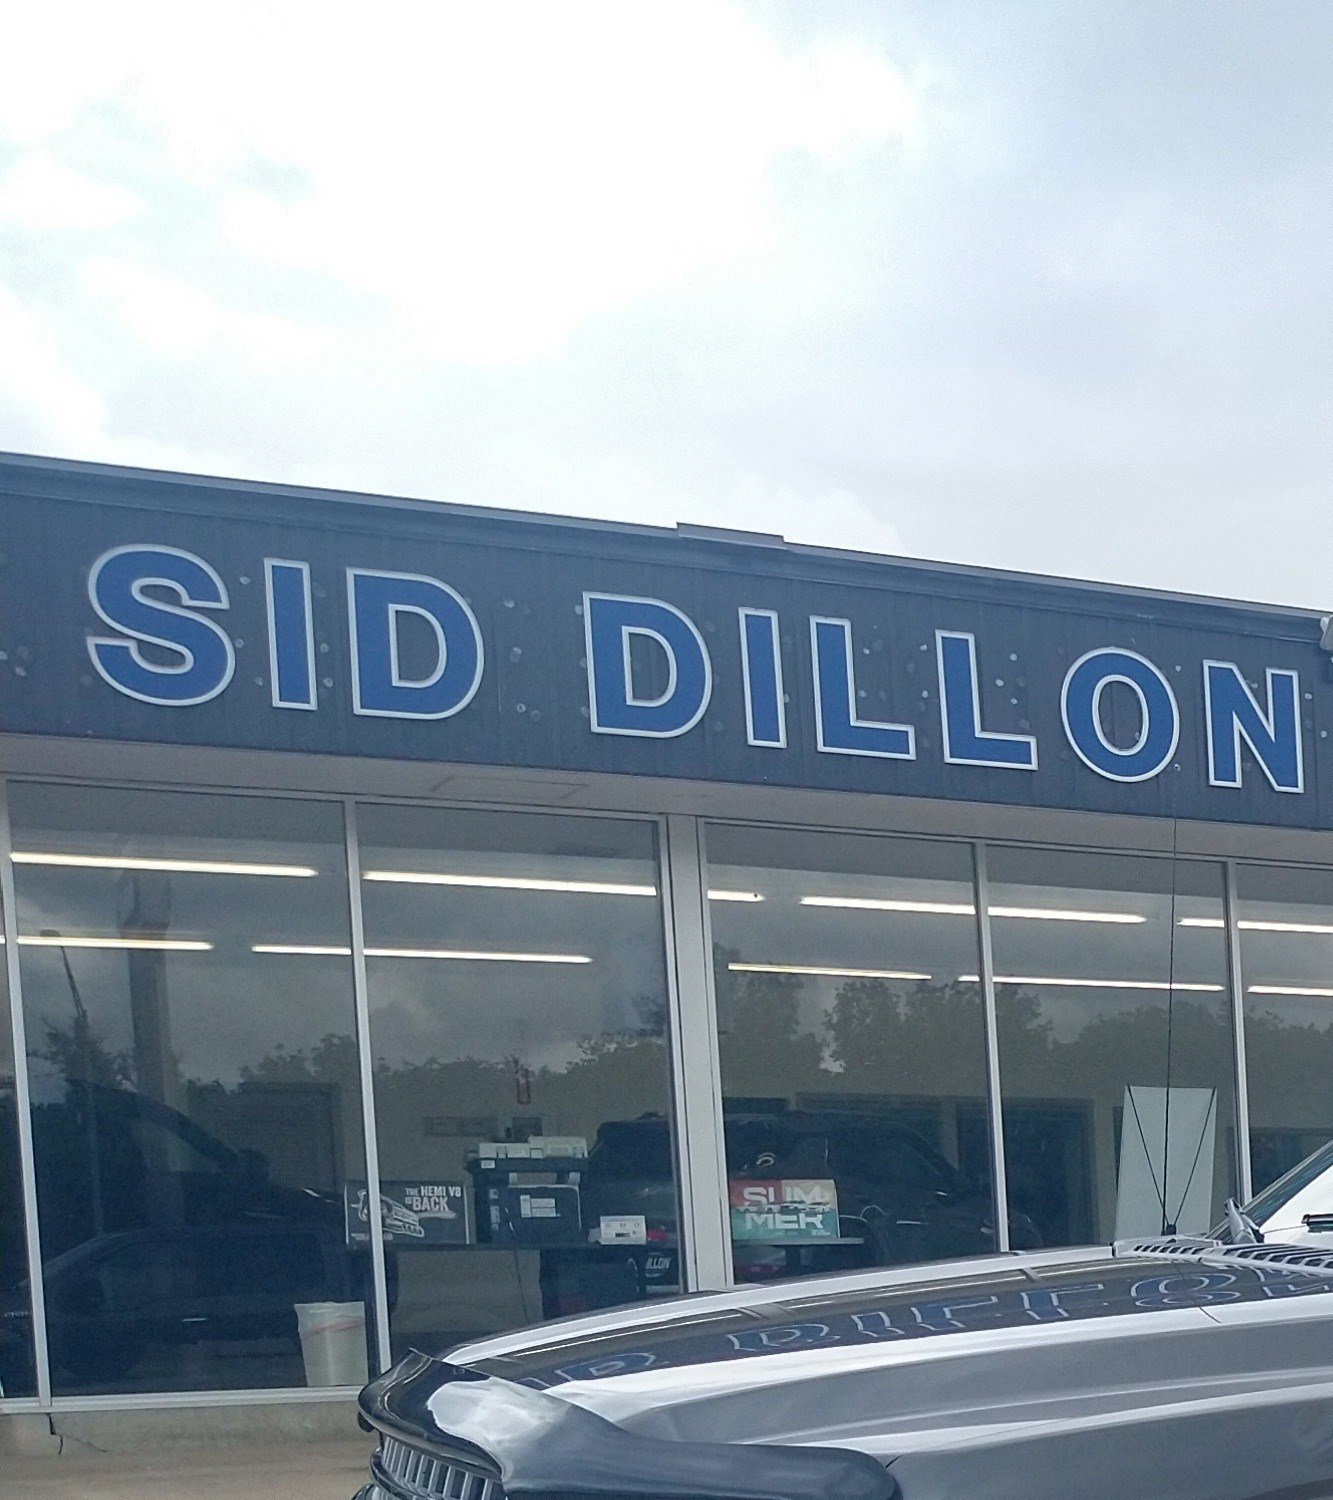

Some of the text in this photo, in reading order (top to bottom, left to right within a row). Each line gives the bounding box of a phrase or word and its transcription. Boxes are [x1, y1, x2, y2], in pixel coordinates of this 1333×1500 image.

[86, 543, 1304, 794] SID DILLON
[404, 1185, 462, 1198] THE HEMI V8
[412, 1196, 449, 1211] BACK
[745, 1212, 824, 1230] MER
